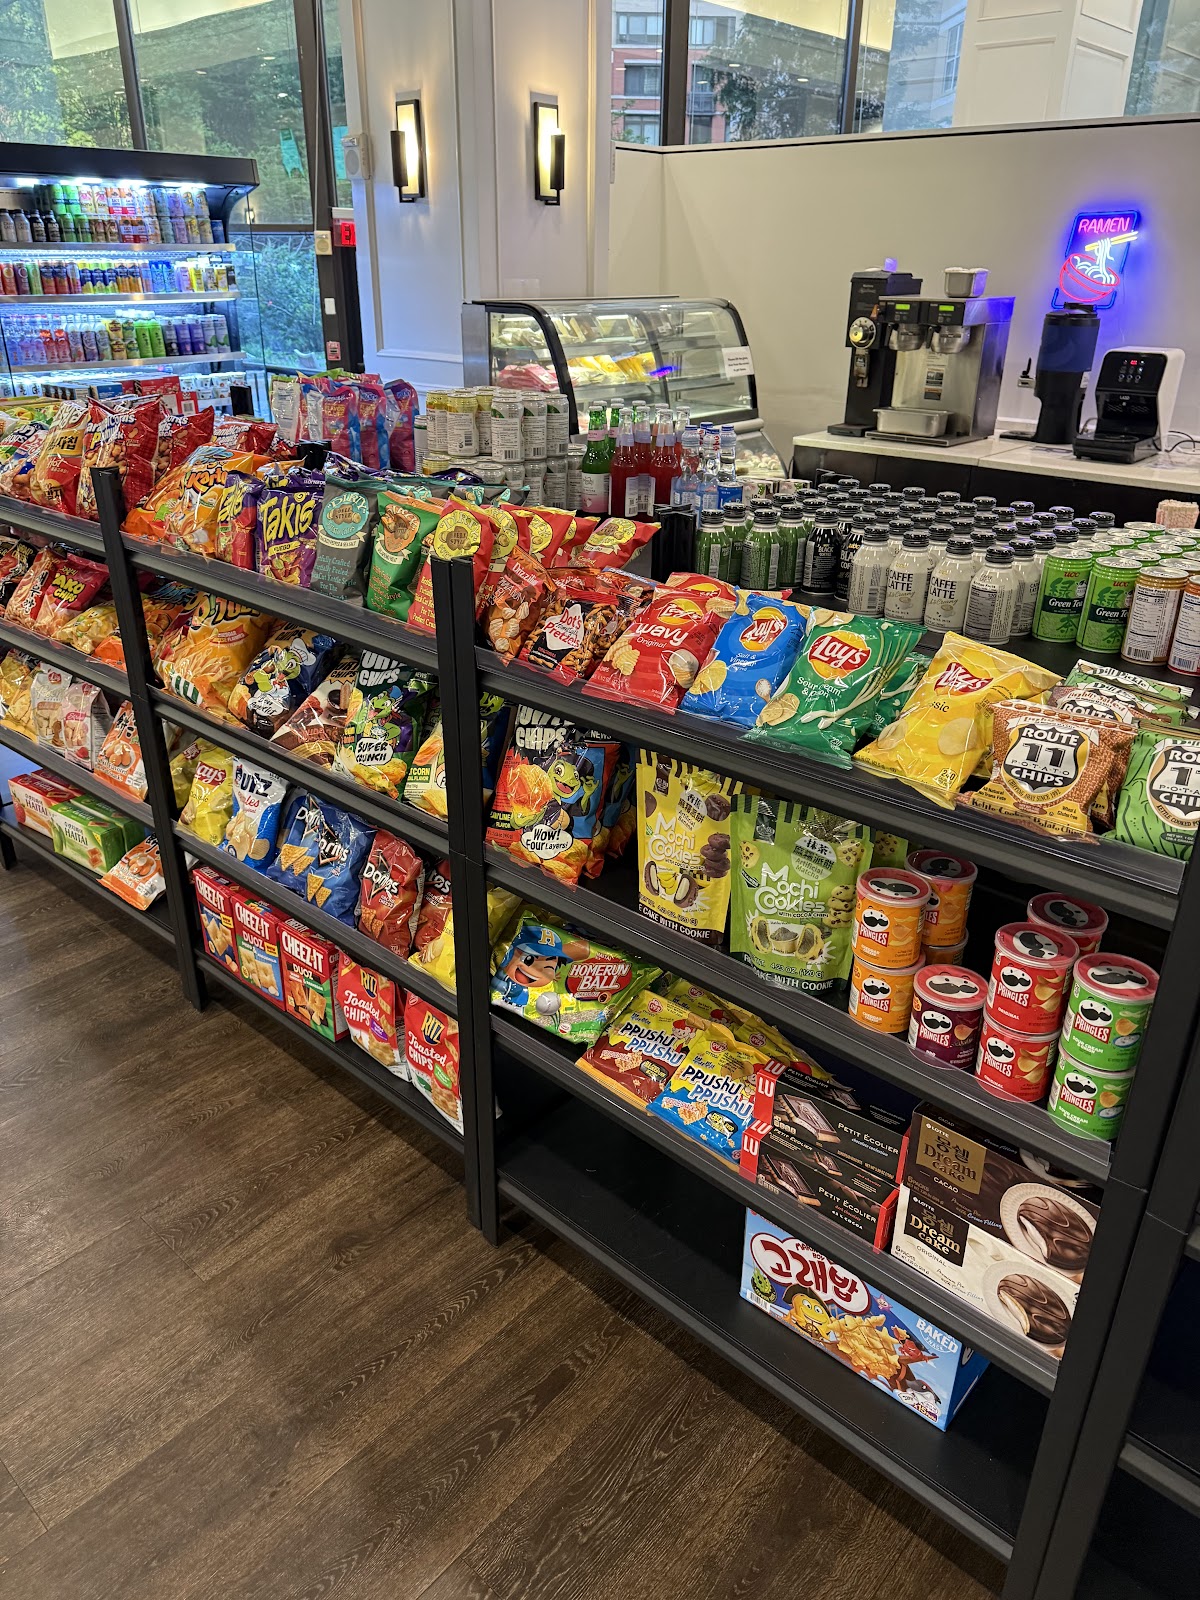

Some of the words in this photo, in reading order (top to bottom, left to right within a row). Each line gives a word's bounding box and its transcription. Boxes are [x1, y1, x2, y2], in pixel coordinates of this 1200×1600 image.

[1077, 216, 1130, 234] RAMEN
[260, 493, 316, 550] Takis
[52, 573, 86, 594] AKO
[889, 569, 914, 582] CAFFE
[931, 576, 957, 590] CAFFE
[54, 588, 77, 603] CHIPS
[888, 581, 912, 592] LATTE
[929, 588, 956, 600] LATTE
[1048, 598, 1070, 608] Green
[1095, 607, 1119, 618] Green
[560, 608, 582, 630] Dot's
[543, 622, 580, 648] Pretzels
[744, 618, 786, 643] Lay's
[636, 636, 667, 649] Original
[812, 636, 867, 668] Lay's
[359, 669, 401, 687] CHIPS
[1099, 667, 1115, 677] Dill
[797, 677, 818, 691] Sour
[801, 687, 810, 696] &
[358, 742, 388, 752] SUPER
[516, 726, 567, 750] CHIPS
[1021, 728, 1079, 746] ROUTE
[356, 753, 387, 762] CRUNCH
[1022, 742, 1067, 767] 11
[409, 767, 430, 776] TCORN
[1011, 768, 1064, 787] CHIPS
[65, 828, 89, 846] HAITAI
[654, 812, 696, 850] Mochi
[526, 839, 545, 851] Four
[545, 842, 569, 850] Layers!
[649, 834, 701, 865] Cookies
[806, 838, 828, 856] 抹茶
[795, 858, 823, 875] Artificial
[796, 865, 820, 880] Matcha
[761, 862, 820, 899] Mochi
[195, 875, 225, 912] CHEEZ-IT
[754, 886, 826, 915] Cookies
[234, 902, 270, 940] CHEEZ-IT
[642, 906, 659, 922] CAKE
[660, 916, 678, 931] WITH
[680, 925, 710, 939] COOKIE
[243, 931, 265, 950] DUOZ
[538, 929, 556, 946] H
[860, 924, 888, 946] PRINGLES
[282, 930, 323, 973] CHEEZ-IT
[293, 963, 314, 980] DUOZ
[570, 963, 632, 977] HOMERUN
[360, 968, 377, 999] RITZ
[578, 975, 620, 990] BALL
[774, 975, 799, 988] WITH
[801, 980, 834, 991] COOKIE
[344, 990, 380, 1021] Toasted
[860, 991, 890, 1012] PRINGLES
[998, 985, 1029, 1007] PRINGLES
[344, 1005, 370, 1026] CHIPS
[998, 1007, 1020, 1020] ORIGINAL
[421, 1010, 445, 1043] RITZ
[920, 1024, 950, 1047] PRINGLES
[1075, 1014, 1110, 1043] PRINGLES
[408, 1031, 447, 1067] Toasted
[1072, 1036, 1085, 1045] SOUR
[1085, 1042, 1104, 1053] CREAM
[409, 1045, 433, 1071] CHIPS
[764, 1060, 786, 1076] LU
[984, 1054, 1012, 1077] PRINGLES
[758, 1077, 776, 1098] LU
[1061, 1085, 1095, 1114] PRINGLES
[750, 1120, 773, 1134] LU
[931, 1126, 949, 1138] LOTTE
[743, 1136, 760, 1156] LU
[774, 1128, 790, 1140] PETIT
[790, 1136, 813, 1151] ÉCOLIER
[838, 1122, 861, 1138] PETIT
[863, 1134, 899, 1155] ÉCOLIER
[923, 1144, 976, 1182] Dream
[932, 1160, 966, 1184] cake
[933, 1176, 960, 1194] CACAO
[818, 1186, 841, 1203] PETIT
[842, 1200, 878, 1223] ÉCOLIER
[918, 1200, 936, 1212] LOTTE
[910, 1214, 961, 1255] Dream
[984, 1219, 1002, 1230] Filling
[918, 1232, 950, 1256] cake
[916, 1246, 948, 1268] ORIGINAL
[760, 1240, 860, 1304] 고래밥
[966, 1291, 984, 1302] Filling
[916, 1318, 959, 1354] BAKED
